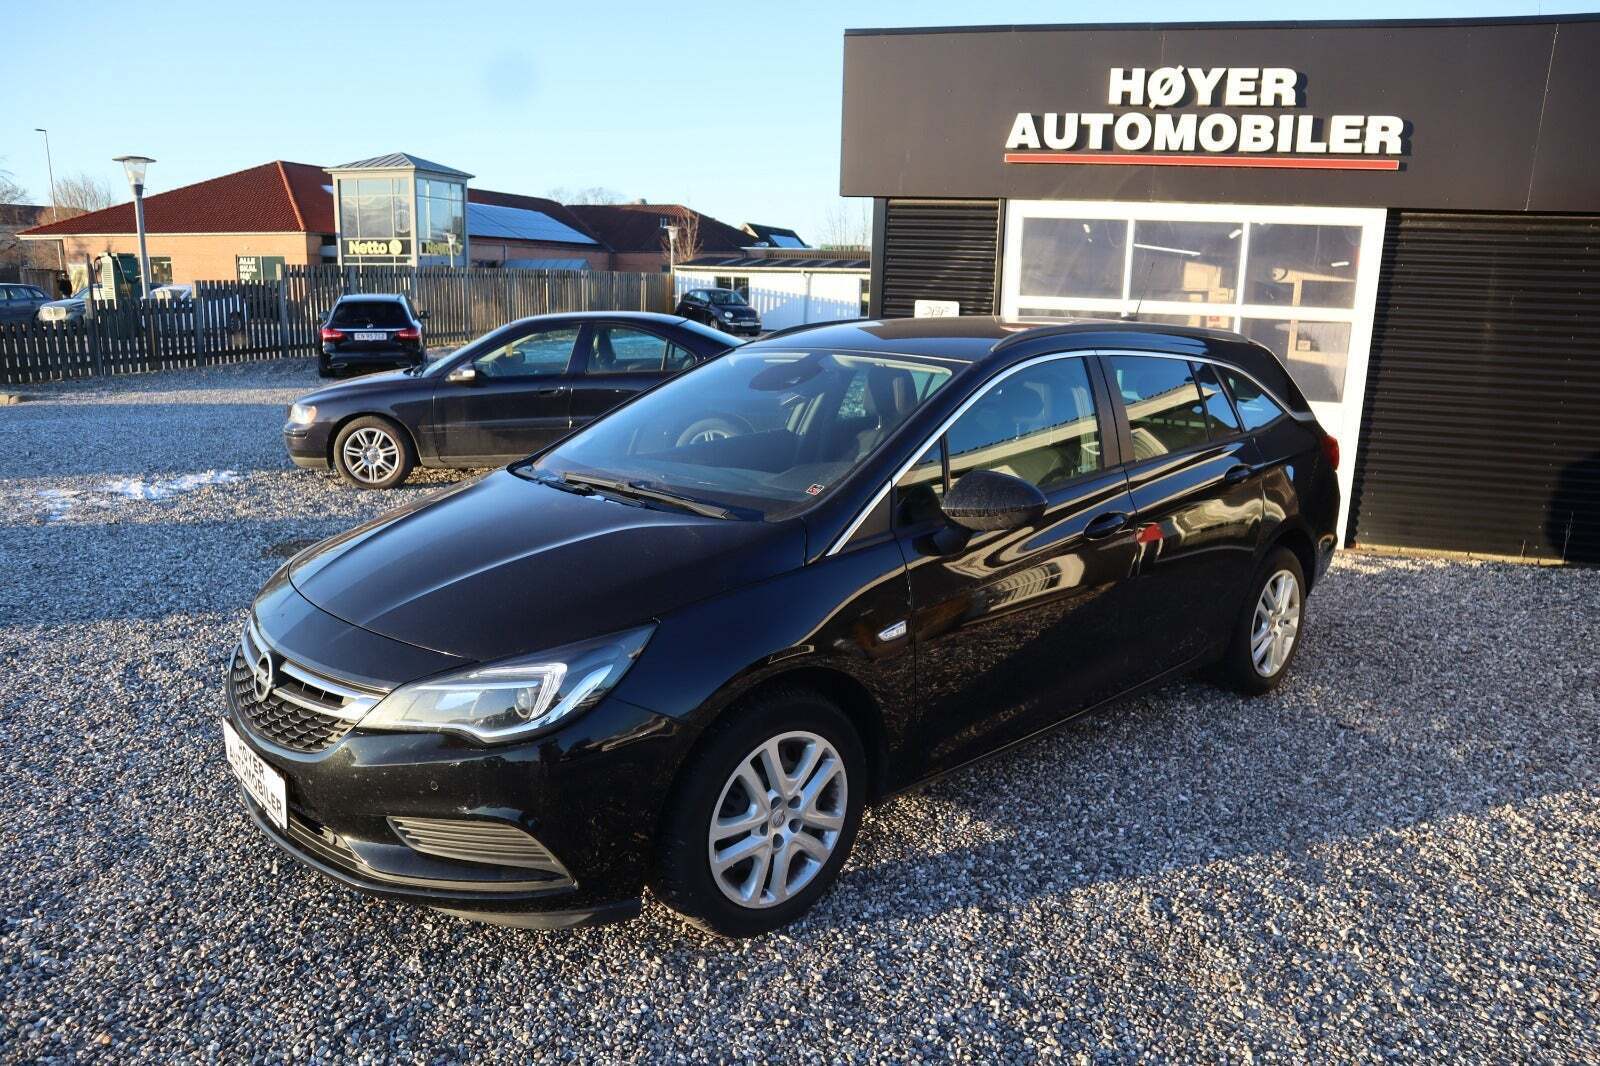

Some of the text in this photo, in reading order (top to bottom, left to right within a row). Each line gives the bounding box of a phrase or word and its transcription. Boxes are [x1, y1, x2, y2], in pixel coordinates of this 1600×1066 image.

[1108, 65, 1297, 109] HØYER
[1005, 112, 1403, 155] AUTOMOBILER
[348, 240, 388, 255] Netto
